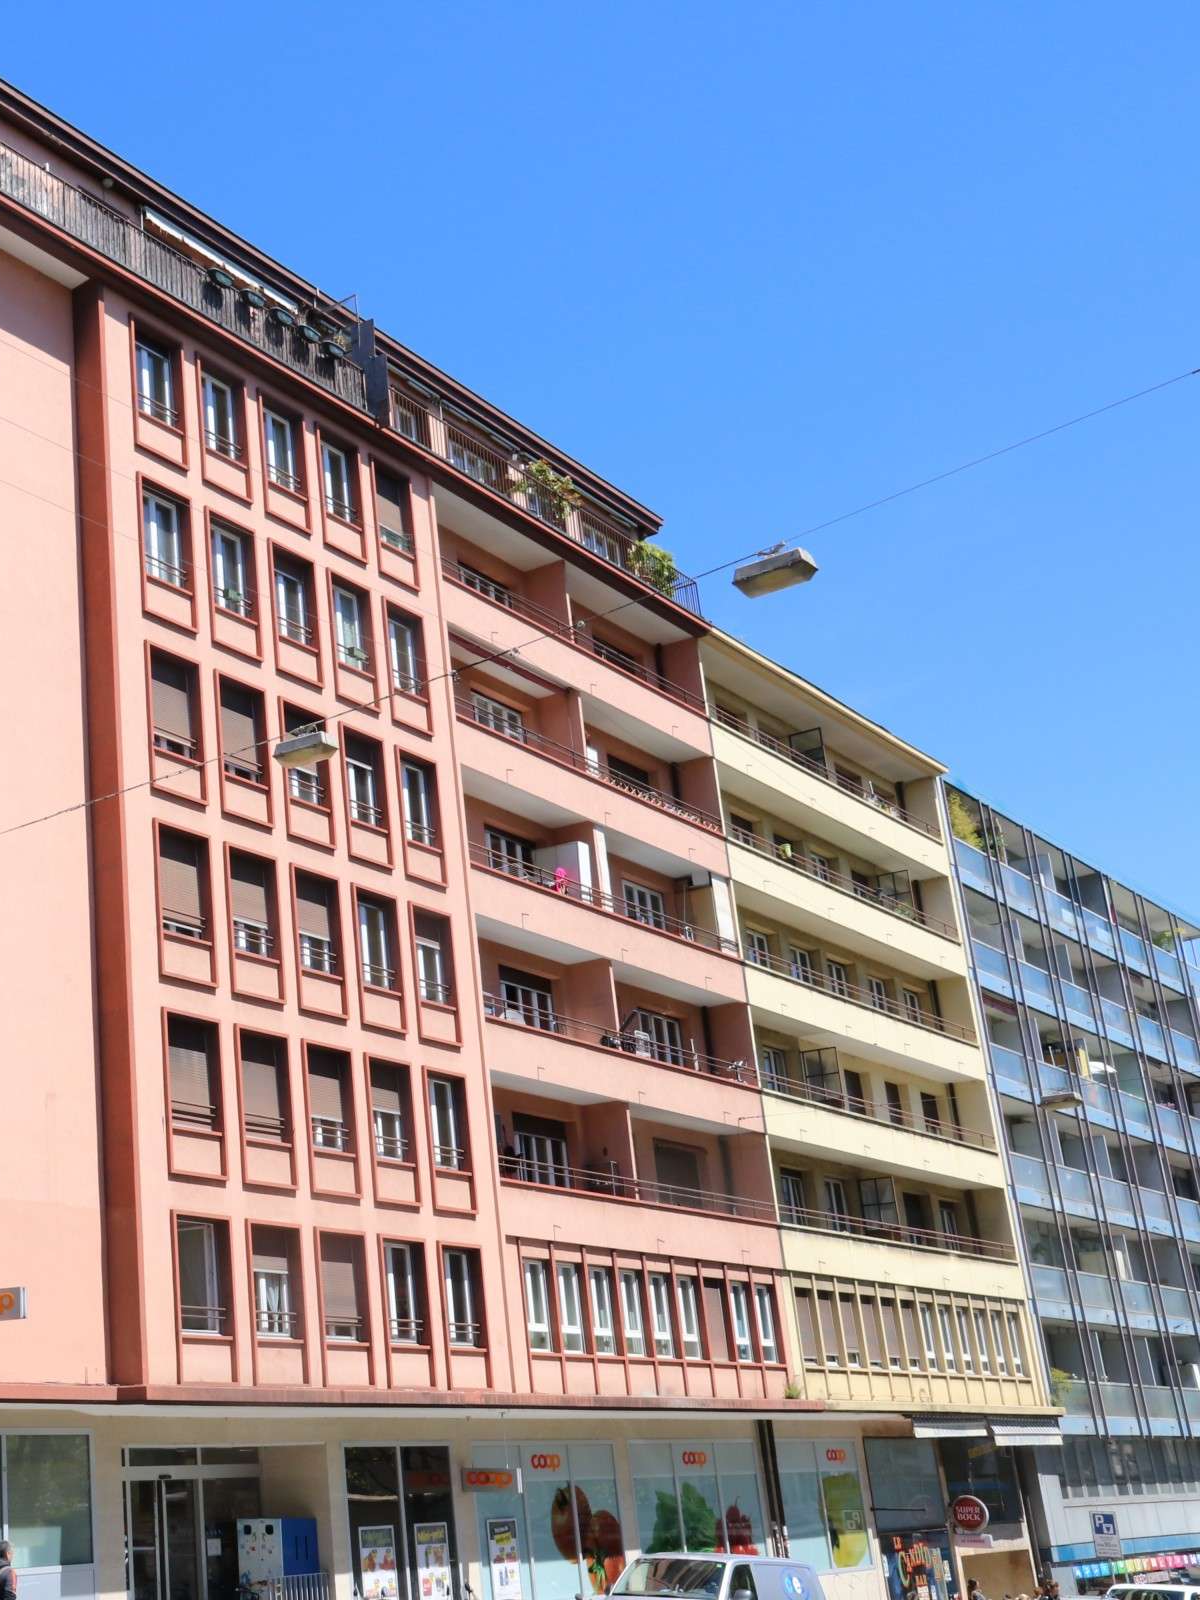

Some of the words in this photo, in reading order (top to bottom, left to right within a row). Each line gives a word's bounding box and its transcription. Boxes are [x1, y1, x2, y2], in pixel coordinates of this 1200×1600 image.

[531, 1453, 561, 1472] coop
[682, 1451, 707, 1467] coop
[825, 1448, 846, 1464] coop
[466, 1471, 513, 1489] coop
[955, 1505, 981, 1514] SUPER
[957, 1513, 981, 1521] BOCK
[1094, 1514, 1104, 1528] P
